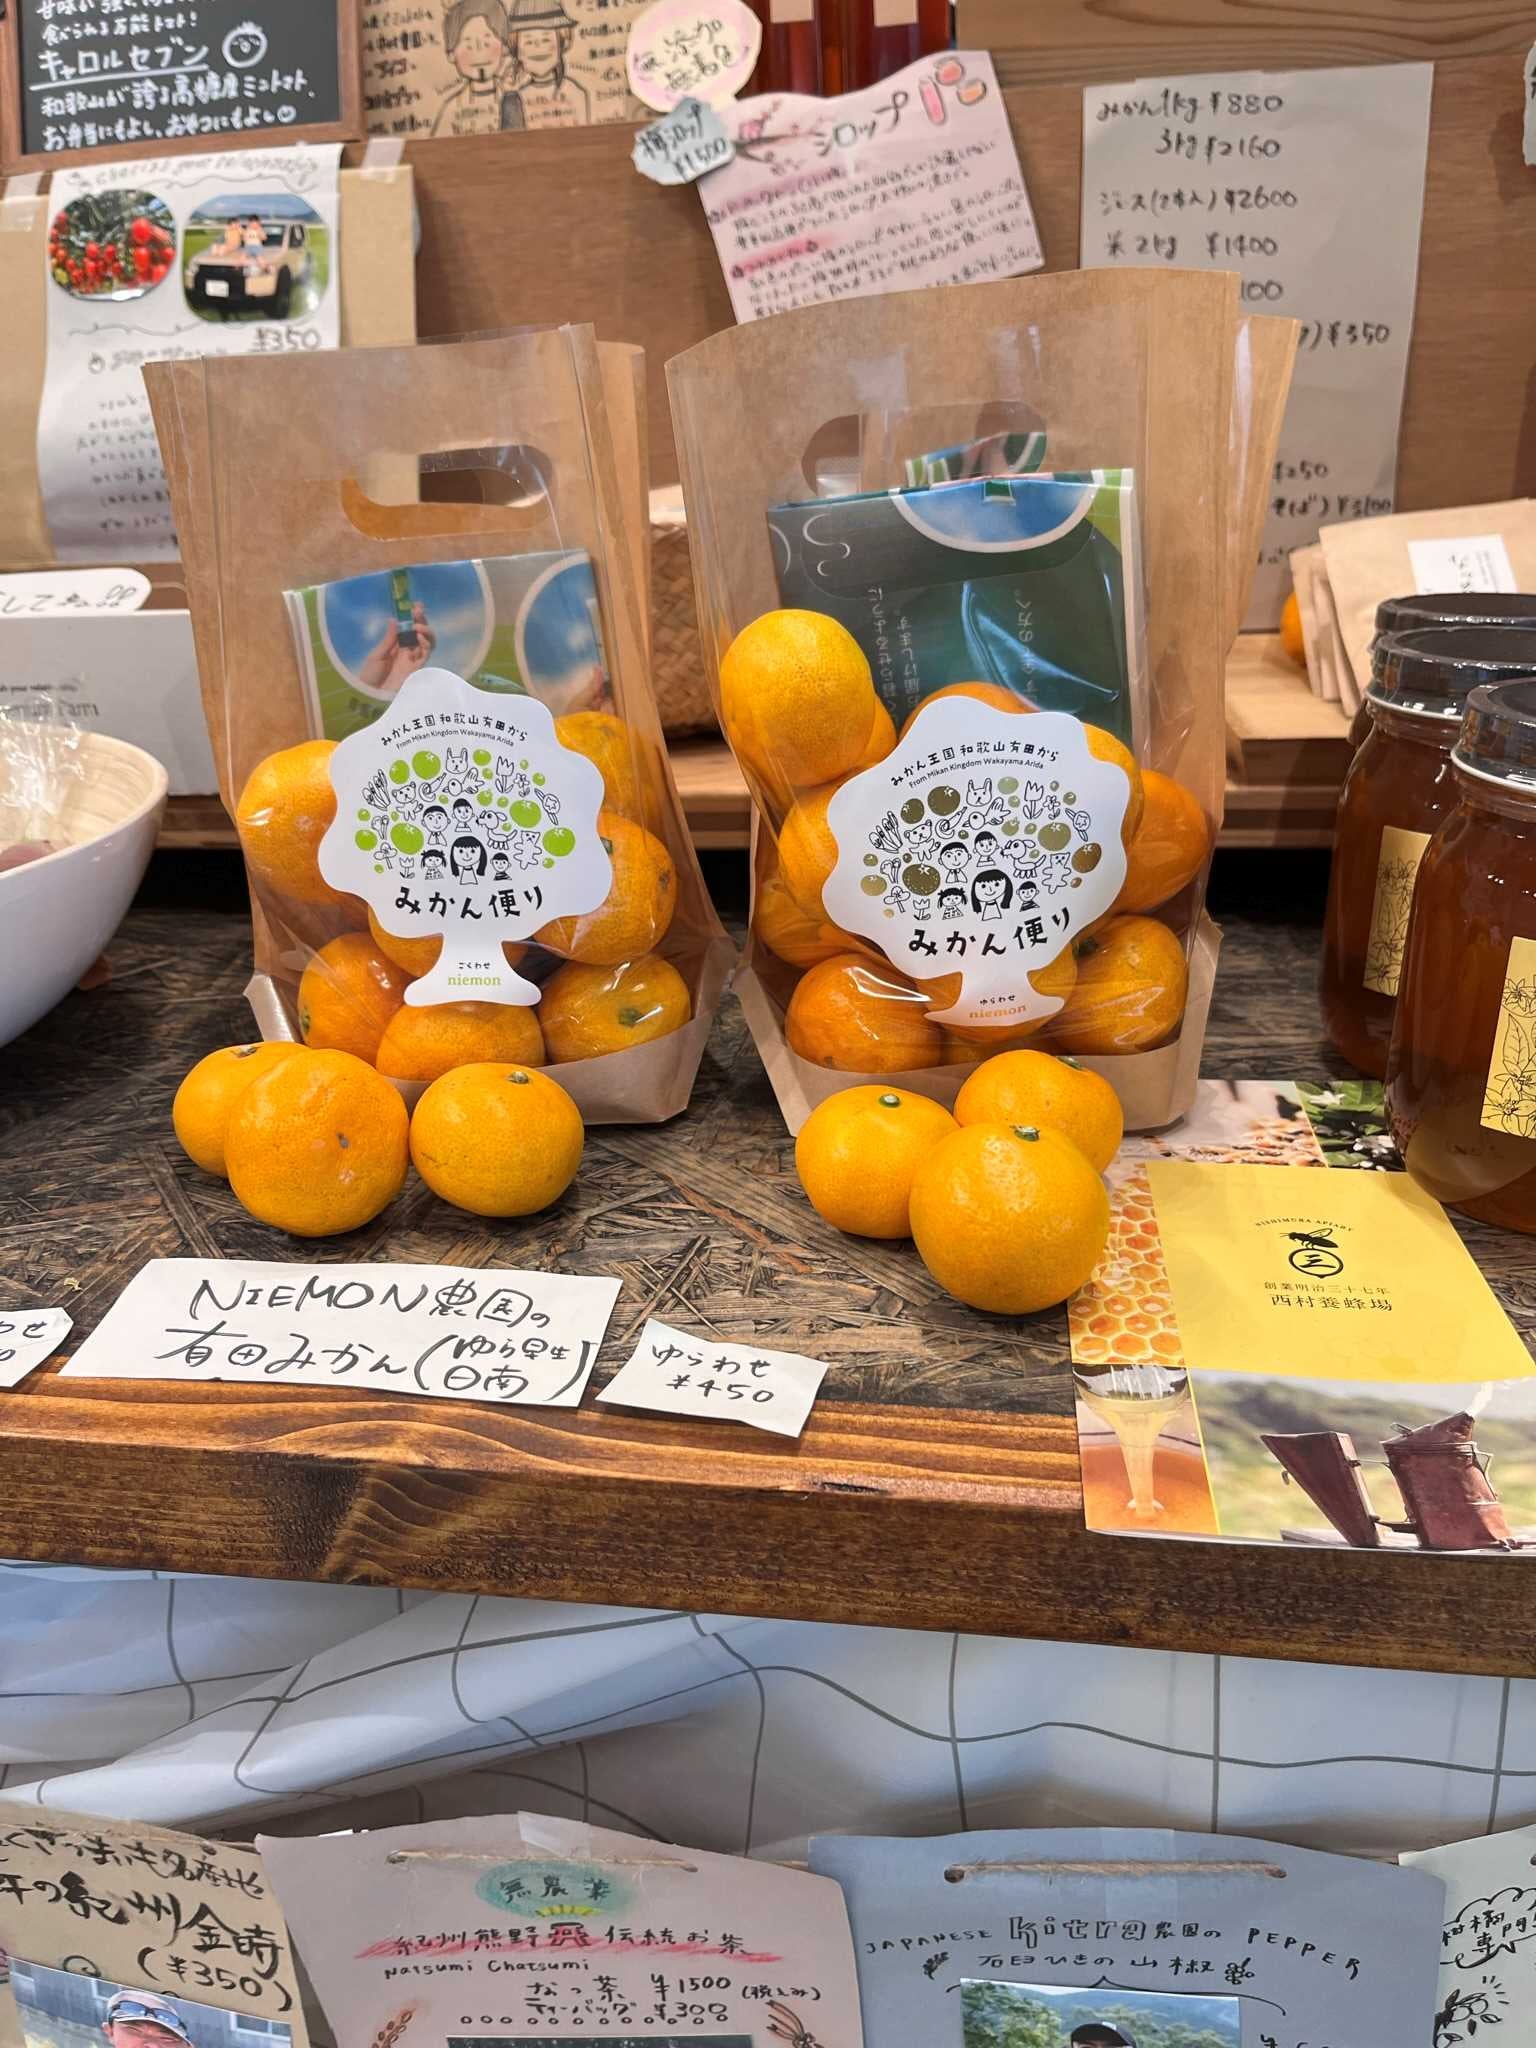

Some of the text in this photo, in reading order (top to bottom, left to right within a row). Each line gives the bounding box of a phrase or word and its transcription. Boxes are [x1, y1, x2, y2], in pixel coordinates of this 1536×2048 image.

[38, 35, 210, 82] キャロルセブン
[1209, 91, 1284, 116] ¥880
[814, 91, 908, 157] シロップ
[1154, 127, 1199, 159] 3kg
[1225, 184, 1298, 214] ¥2600
[381, 712, 528, 747] みかん王国 和歌山有田から
[430, 728, 459, 739] Kingdom
[460, 728, 496, 741] Wakayama
[891, 740, 1060, 787] みかん王国 和歌山有田から
[950, 760, 983, 771] Kingdom
[983, 758, 1024, 767] Wakayama
[1024, 760, 1044, 769] Arida
[395, 886, 543, 920] みかん便り
[908, 907, 1070, 957] みかん便り
[447, 975, 501, 987] niemon
[969, 1004, 1027, 1019] niemon
[1271, 1294, 1393, 1311] 西村養蜂場
[651, 1344, 773, 1379] ゆらわせ
[665, 1373, 775, 1404] ¥450
[865, 1929, 993, 1954] JAPANESE
[1247, 1927, 1361, 1981] PEPPER
[137, 1946, 293, 2013] (¥350)
[651, 1973, 732, 2002] ¥1500
[653, 2003, 729, 2021] ¥300
